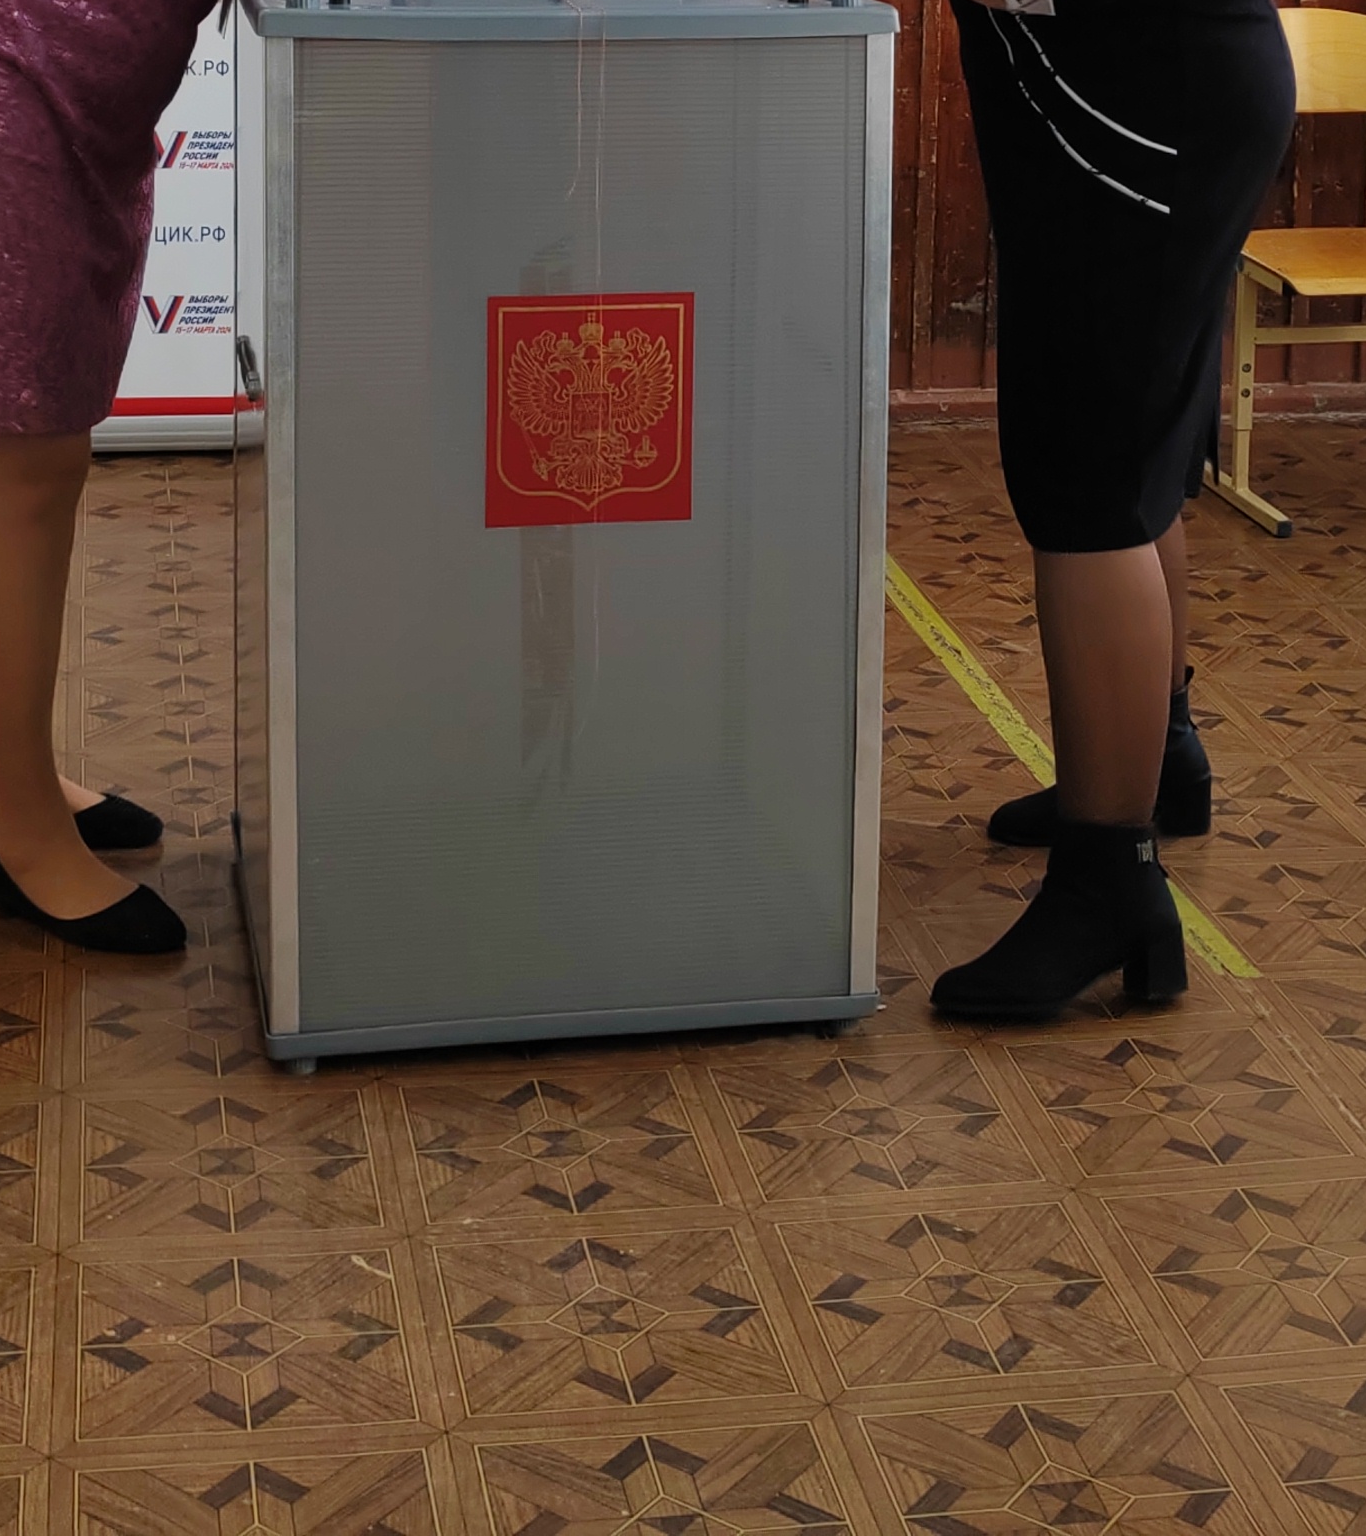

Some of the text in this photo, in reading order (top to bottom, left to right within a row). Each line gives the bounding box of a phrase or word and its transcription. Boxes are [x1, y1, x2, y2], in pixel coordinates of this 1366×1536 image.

[185, 60, 229, 76] К.РФ
[192, 131, 232, 139] ВЫБОРЫ
[187, 141, 234, 150] ПРЕЗИДЕН
[182, 152, 219, 160] РОССИИ
[155, 225, 226, 246] ЦИК.РФ
[188, 295, 229, 303] ВЫБОРЫ
[183, 305, 235, 314] ПРЕЗИДЕНТ
[178, 316, 216, 324] РОССИИ
[193, 326, 215, 334] МАРТА
[215, 327, 232, 335] 2024
